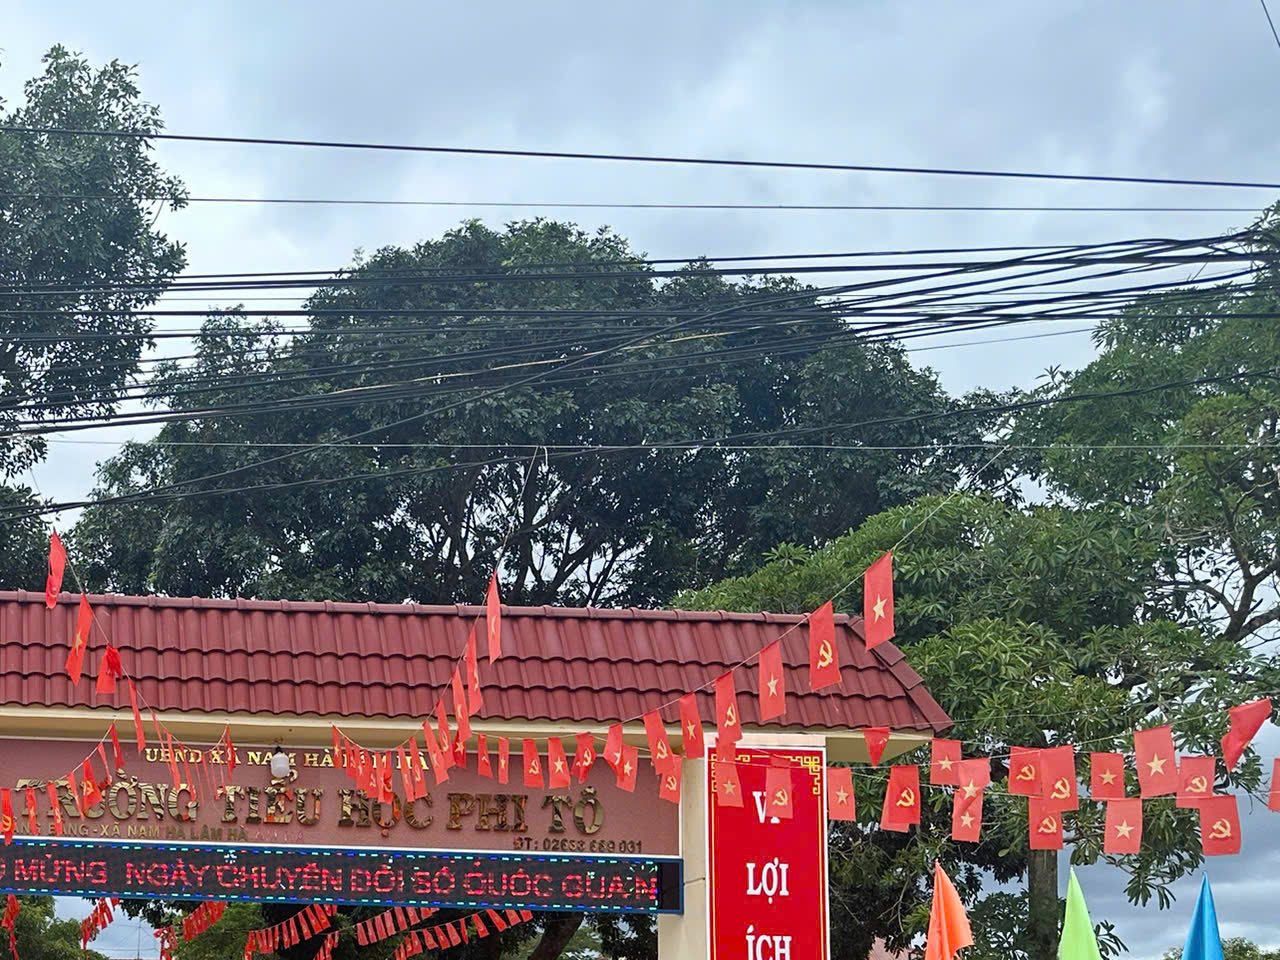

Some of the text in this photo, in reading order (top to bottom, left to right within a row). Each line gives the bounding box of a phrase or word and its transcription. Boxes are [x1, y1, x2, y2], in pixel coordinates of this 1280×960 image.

[303, 748, 335, 767] HÀ
[216, 769, 324, 827] TIỂU
[337, 785, 434, 838] HỌC
[446, 792, 529, 833] PHI
[541, 785, 605, 835] TÔ
[752, 789, 781, 824] V
[127, 824, 160, 839] NAM
[746, 856, 790, 905] LỢI
